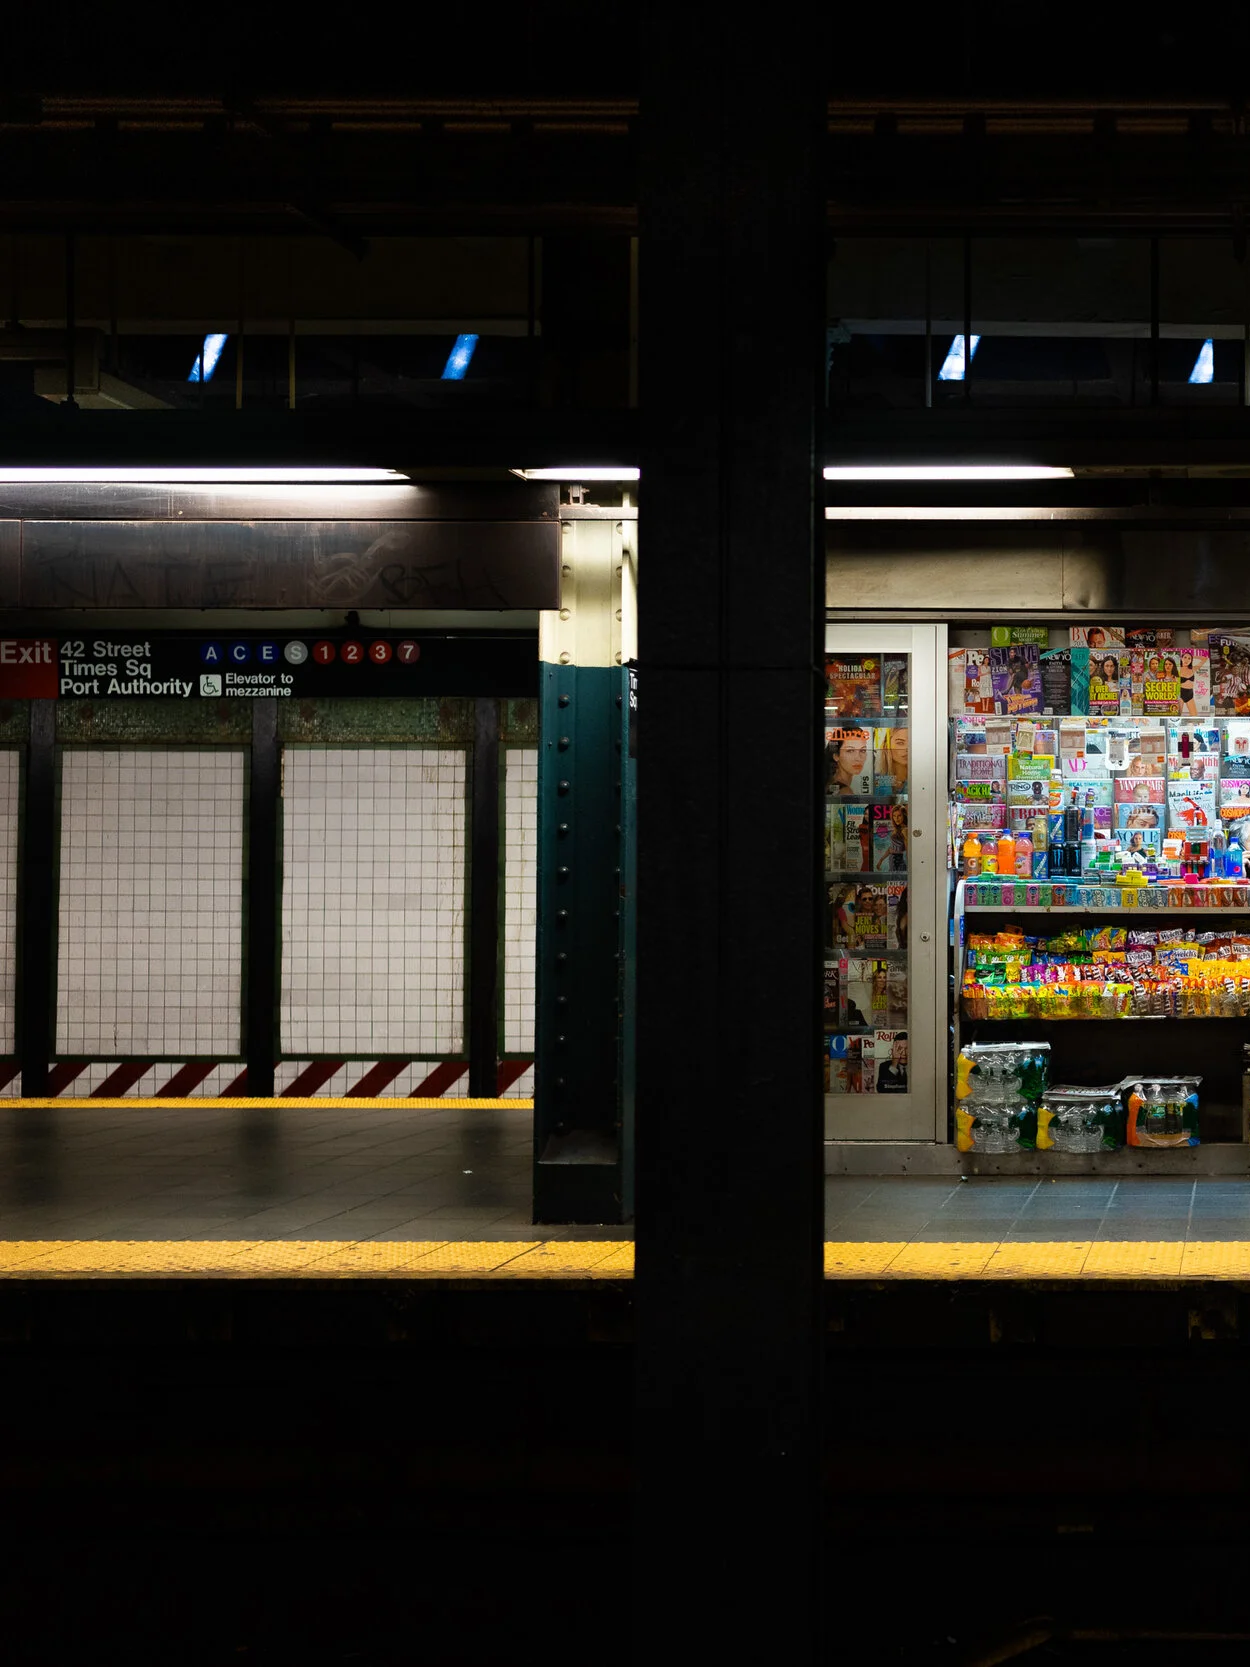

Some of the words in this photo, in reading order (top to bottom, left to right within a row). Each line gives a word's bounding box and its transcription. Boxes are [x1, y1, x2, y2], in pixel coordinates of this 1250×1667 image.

[0, 641, 52, 663] Exit
[60, 641, 86, 657] 42
[93, 641, 151, 657] Street
[205, 646, 218, 660] A
[232, 646, 246, 660] C
[262, 646, 273, 660] E
[290, 646, 302, 660] S
[320, 645, 329, 660] 1
[346, 646, 358, 660] 2
[375, 646, 386, 660] 3
[403, 646, 415, 660] 7
[60, 659, 118, 676] Times
[125, 659, 152, 679] Sq
[837, 664, 866, 672] HOLIDAY
[224, 673, 274, 684] Elevator
[280, 673, 294, 684] to
[829, 672, 876, 680] SPECTACULAR
[60, 678, 100, 694] Port
[107, 678, 194, 697] Authority
[225, 685, 292, 697] mezzanine
[1145, 682, 1178, 692] SECRET
[1145, 691, 1178, 701] WORLDS
[825, 727, 871, 741] allure
[958, 759, 1004, 768] TRADITIONAL
[1146, 780, 1164, 791] FAIR
[846, 820, 856, 828] Fit
[855, 925, 879, 934] MOVES
[1160, 928, 1184, 942] Welch's
[1173, 949, 1197, 959] Welch's
